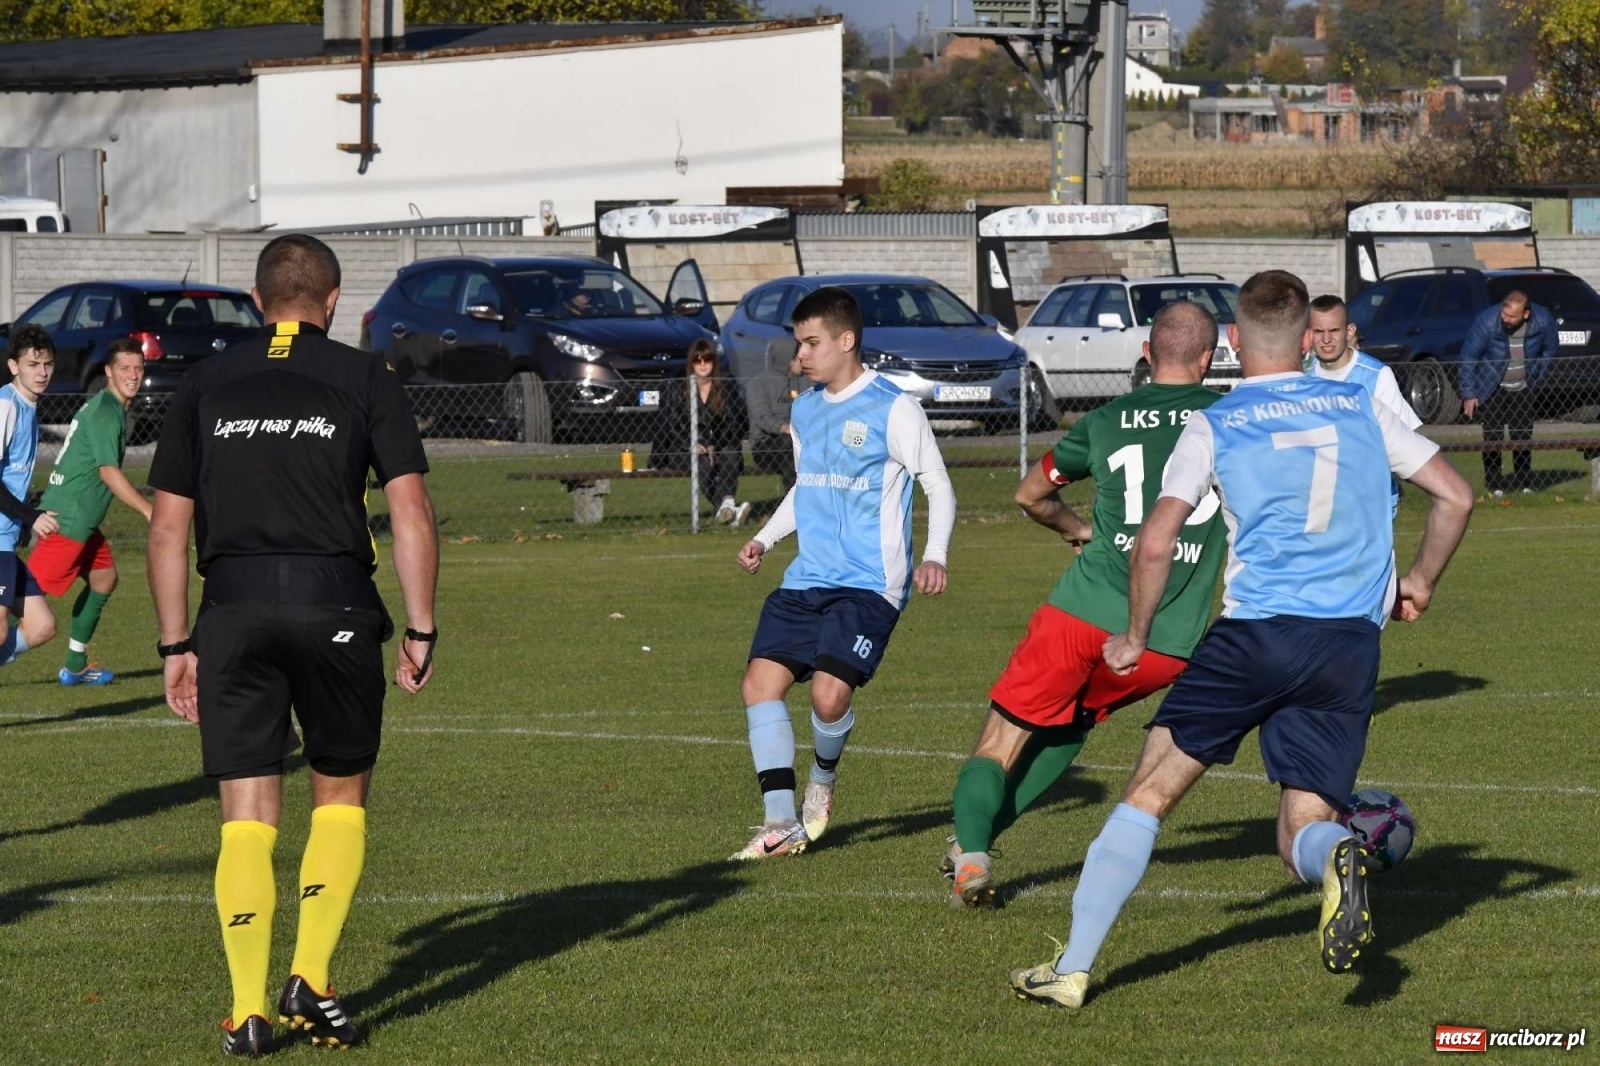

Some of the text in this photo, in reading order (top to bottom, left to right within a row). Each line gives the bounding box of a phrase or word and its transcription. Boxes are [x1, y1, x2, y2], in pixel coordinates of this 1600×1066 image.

[668, 212, 740, 225] KOST-BET
[1047, 212, 1117, 225] KOST-BET
[1414, 208, 1482, 221] KOST-BET
[213, 416, 336, 439] Łączy nas piłka
[1121, 410, 1160, 428] LKS
[1222, 408, 1248, 428] KS
[1270, 424, 1339, 534] 7
[1114, 532, 1203, 564] PAÓW
[852, 634, 873, 659] 16
